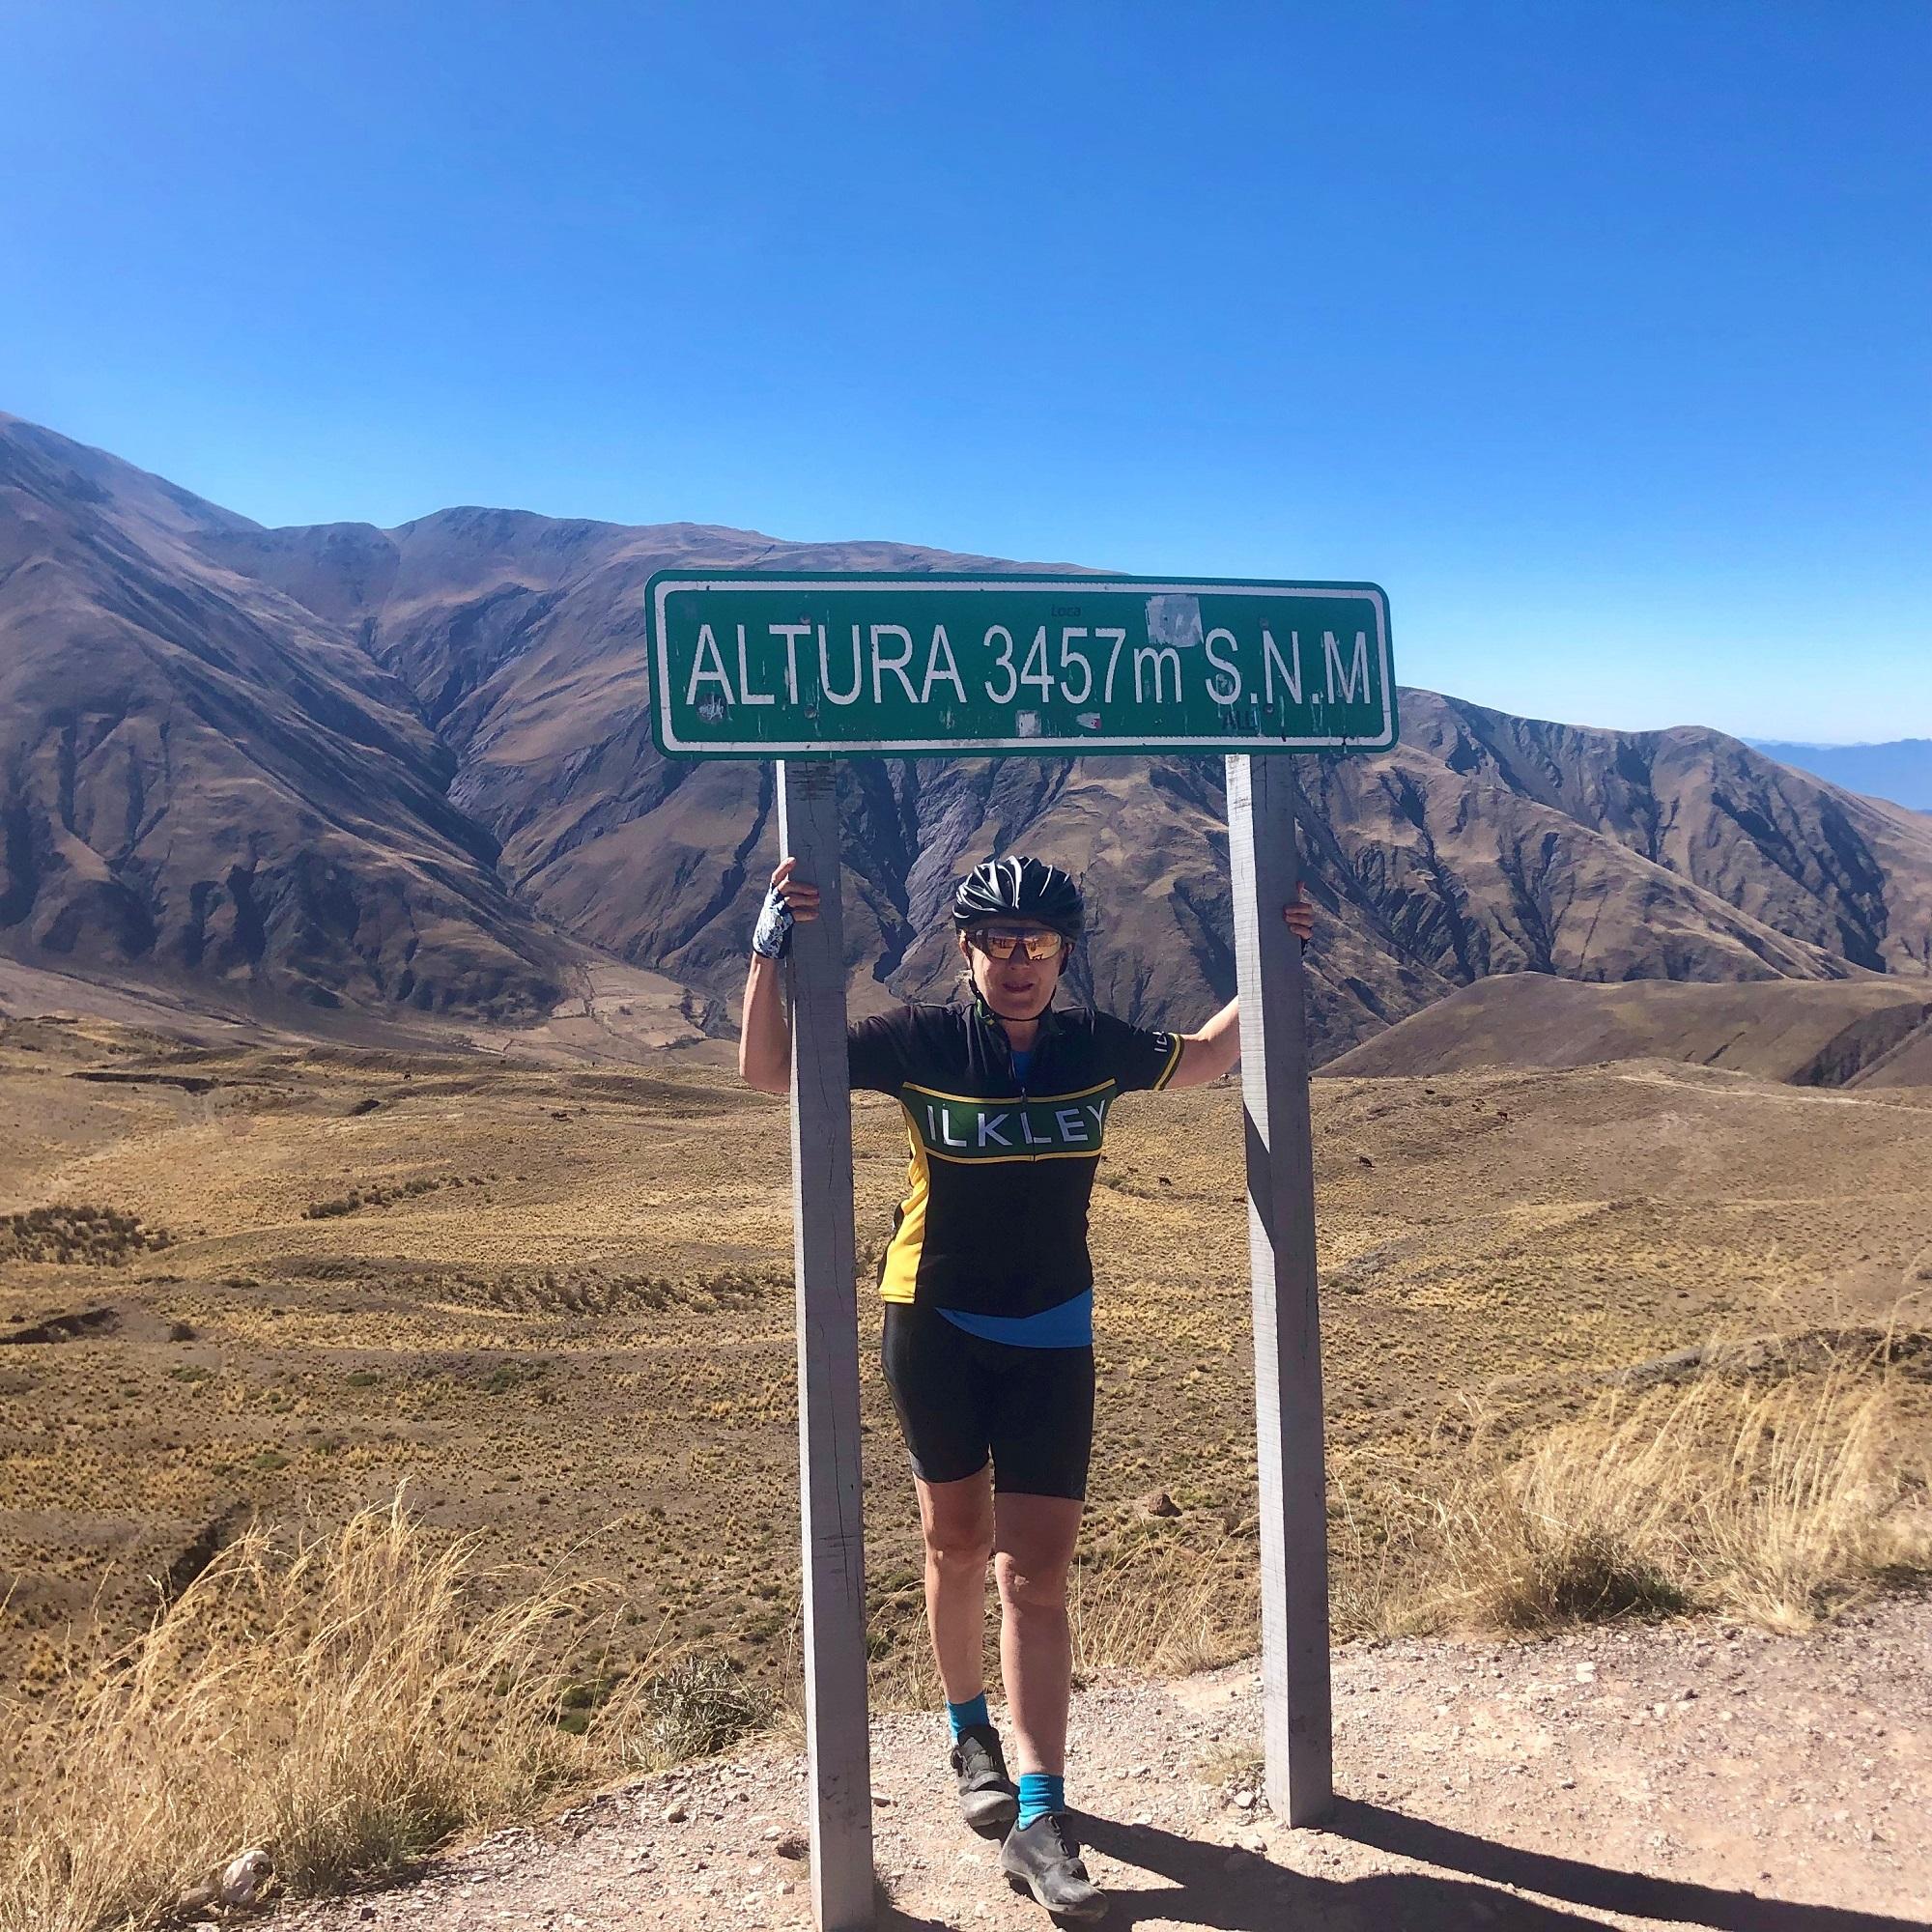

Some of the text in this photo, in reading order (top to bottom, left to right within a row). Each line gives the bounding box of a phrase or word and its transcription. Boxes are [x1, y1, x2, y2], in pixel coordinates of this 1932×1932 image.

[686, 624, 1371, 704] ALTURA 3457m S.N.M
[926, 1099, 1106, 1148] ILKLEY
